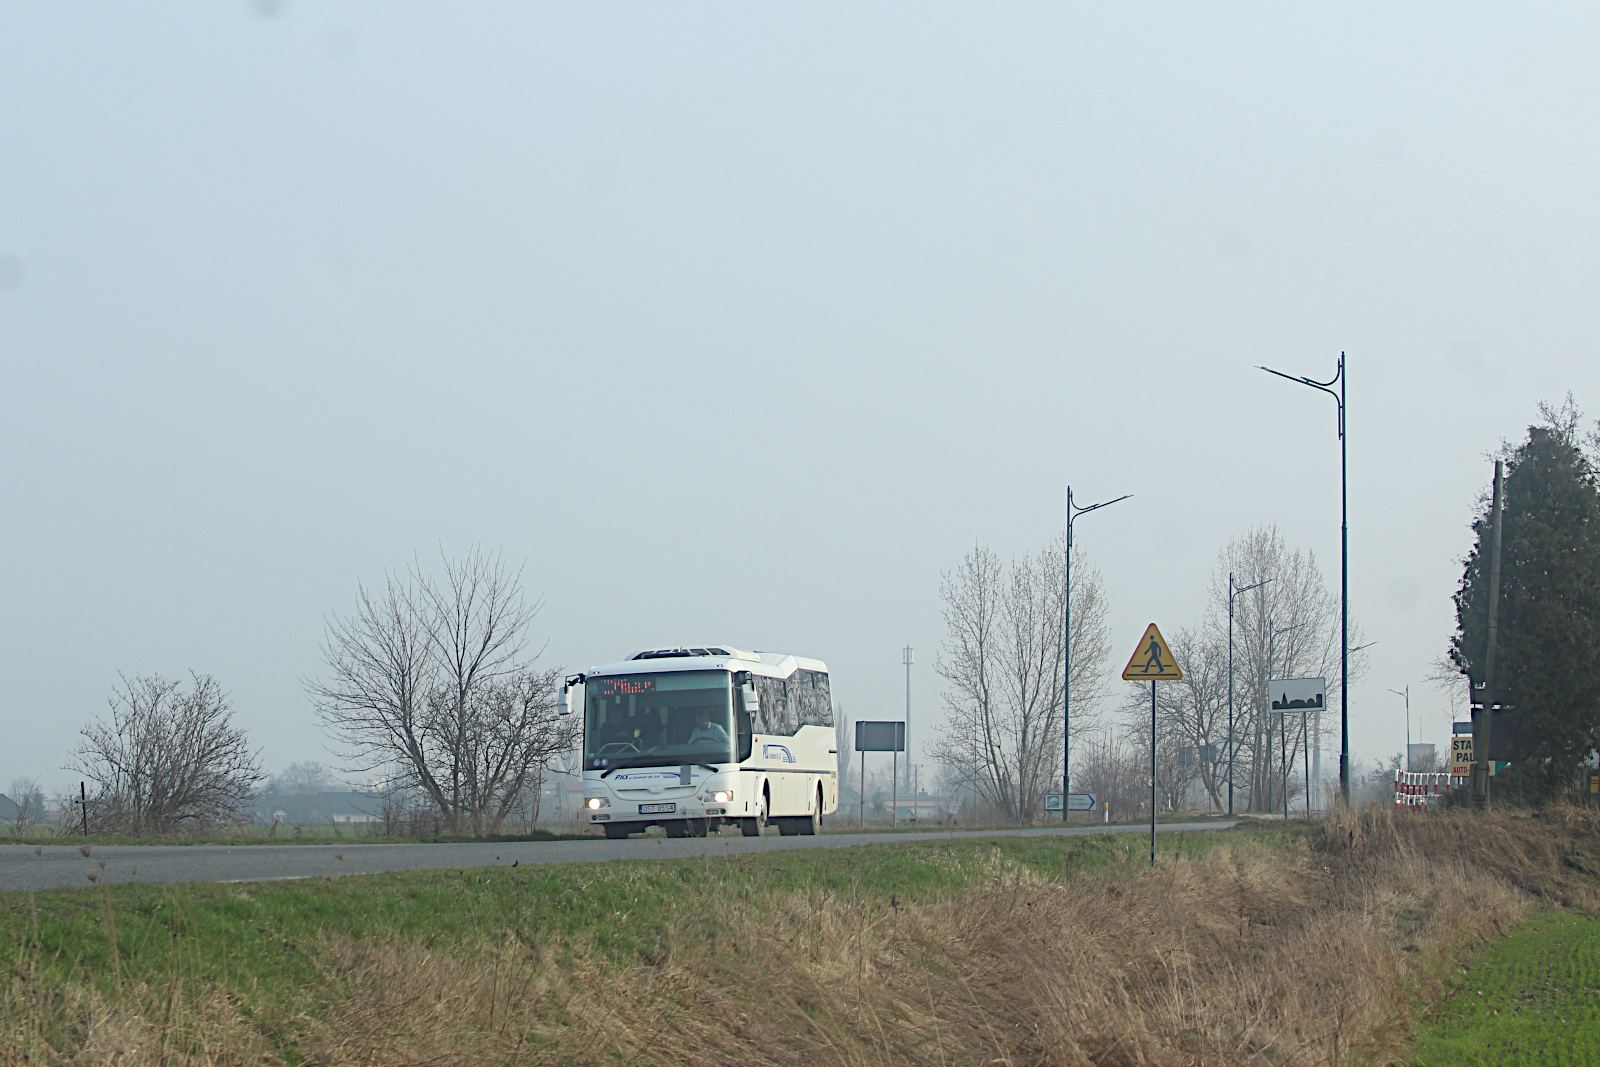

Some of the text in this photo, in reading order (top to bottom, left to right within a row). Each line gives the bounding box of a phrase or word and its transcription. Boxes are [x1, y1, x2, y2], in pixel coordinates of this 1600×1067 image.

[1453, 740, 1472, 750] STA
[1456, 752, 1475, 762] PAL
[1453, 766, 1470, 774] AUTO-
